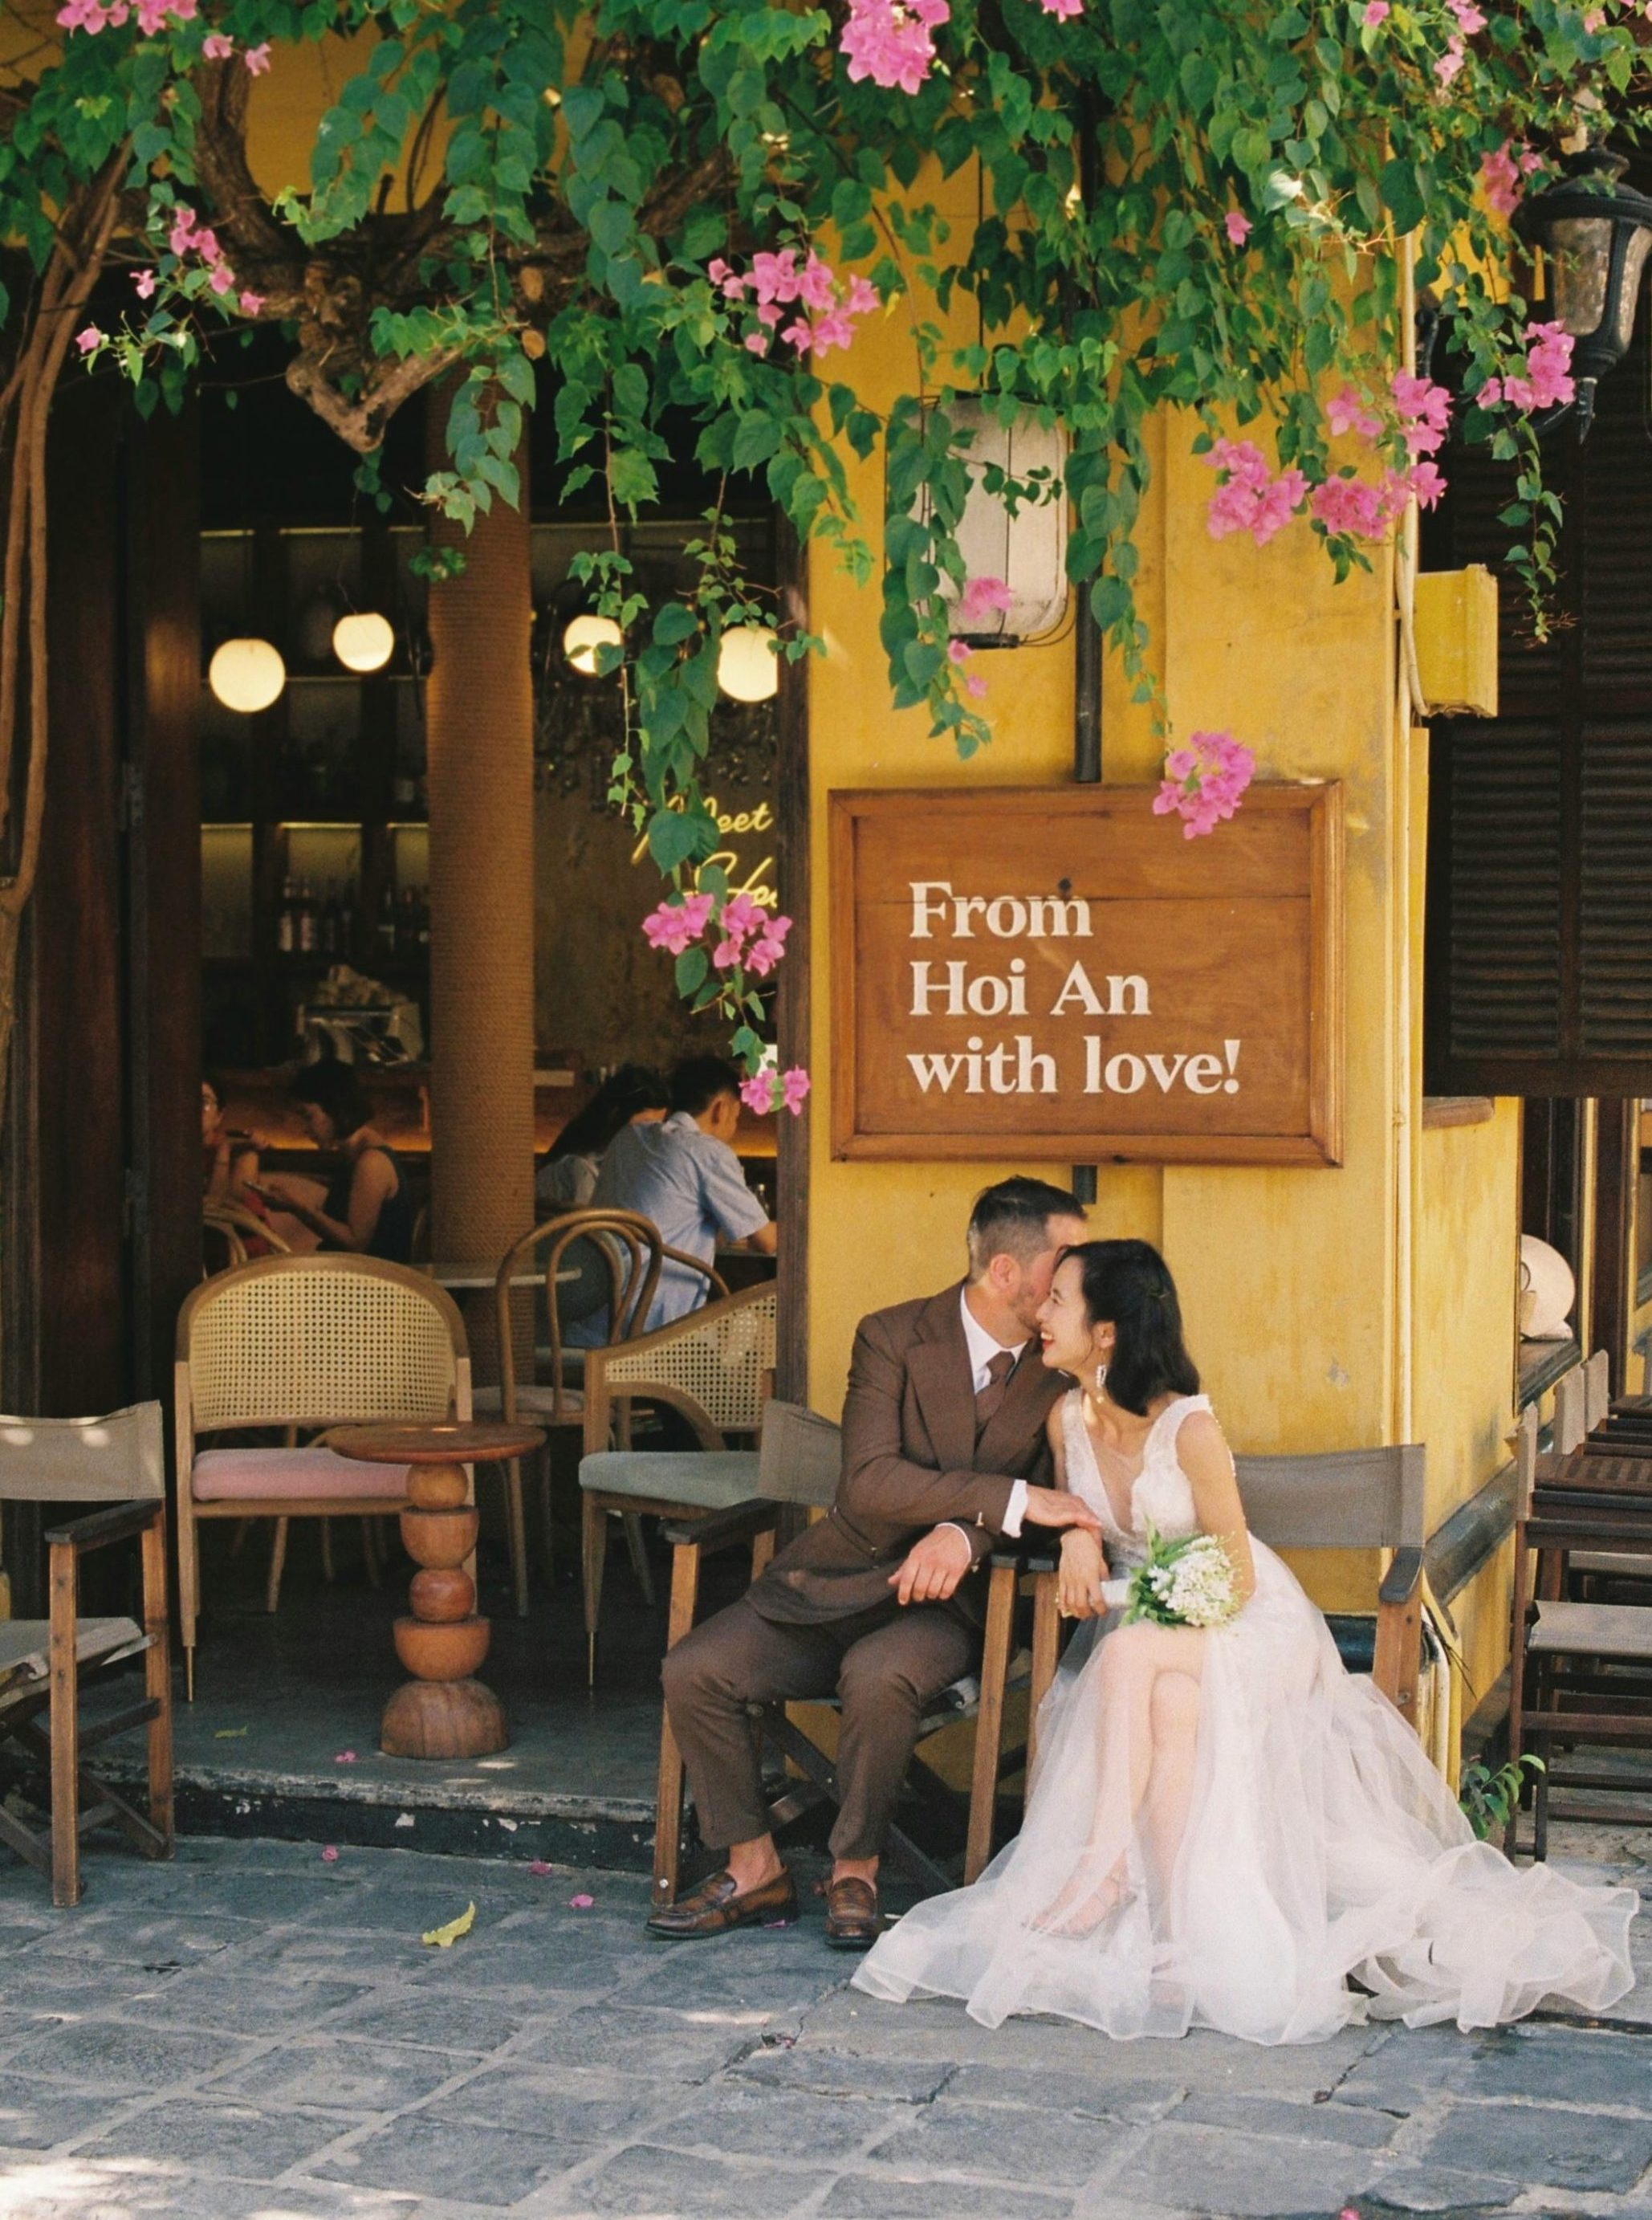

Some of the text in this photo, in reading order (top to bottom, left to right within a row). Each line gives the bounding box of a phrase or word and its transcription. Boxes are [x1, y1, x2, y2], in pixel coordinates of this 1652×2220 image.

[909, 882, 1093, 937] From
[909, 958, 1151, 1016] Hoi An
[906, 1036, 1241, 1094] with love!
